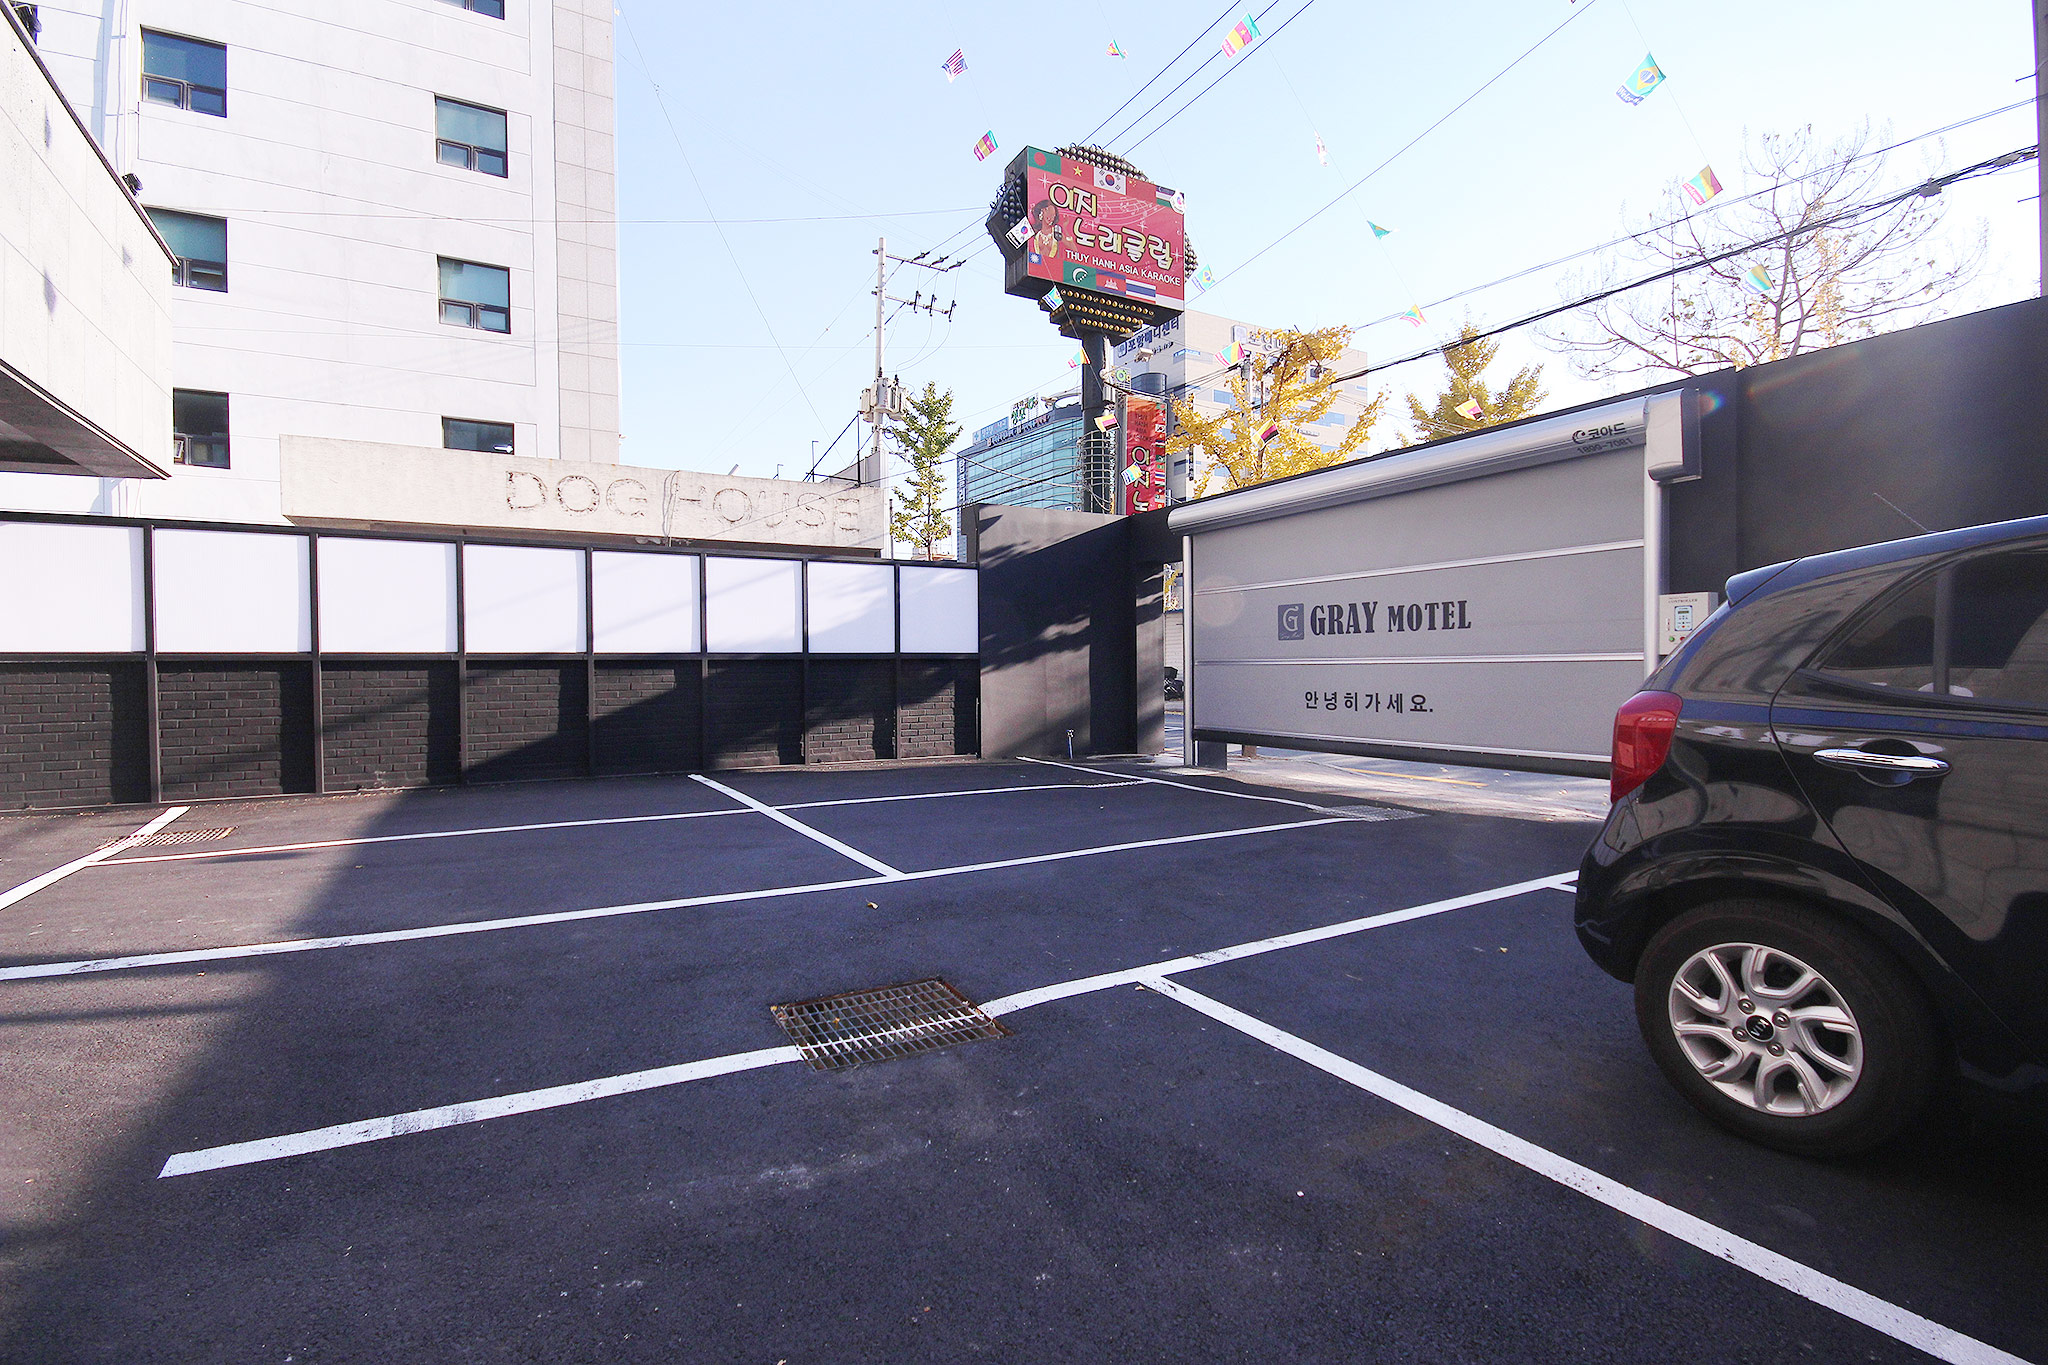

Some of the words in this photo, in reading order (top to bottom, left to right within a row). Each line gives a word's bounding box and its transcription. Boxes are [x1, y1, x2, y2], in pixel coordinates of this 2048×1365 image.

[1073, 218, 1174, 270] 노래클럽
[1065, 249, 1090, 264] THUY
[1092, 256, 1117, 271] HANH
[1118, 263, 1139, 277] ASIA
[1141, 268, 1181, 287] KARAOKE
[1587, 422, 1627, 441] 코아드
[506, 470, 648, 519] DOG
[1310, 601, 1378, 636] GRAY
[1388, 600, 1472, 632] MOTEL
[1304, 691, 1434, 713] 안녕히가세요.
